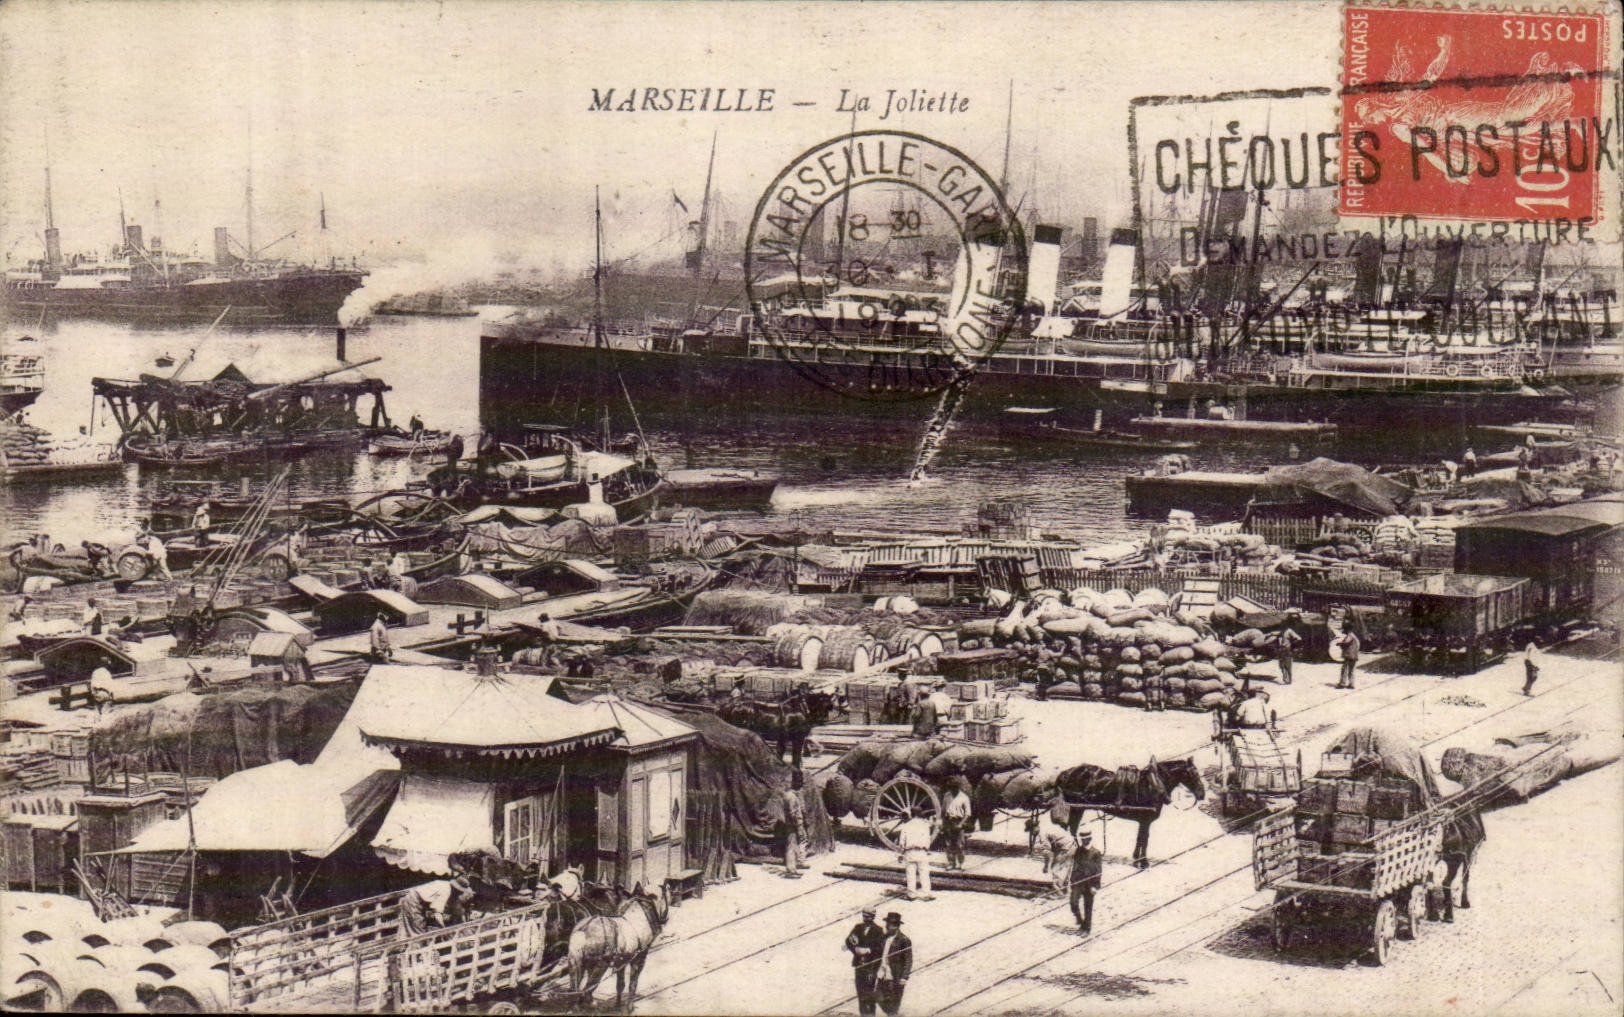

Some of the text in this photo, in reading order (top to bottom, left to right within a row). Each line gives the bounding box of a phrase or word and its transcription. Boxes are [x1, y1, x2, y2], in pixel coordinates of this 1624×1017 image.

[1348, 13, 1370, 92] RANÇAISE
[1502, 19, 1587, 43] POSTES
[1514, 163, 1570, 214] 10
